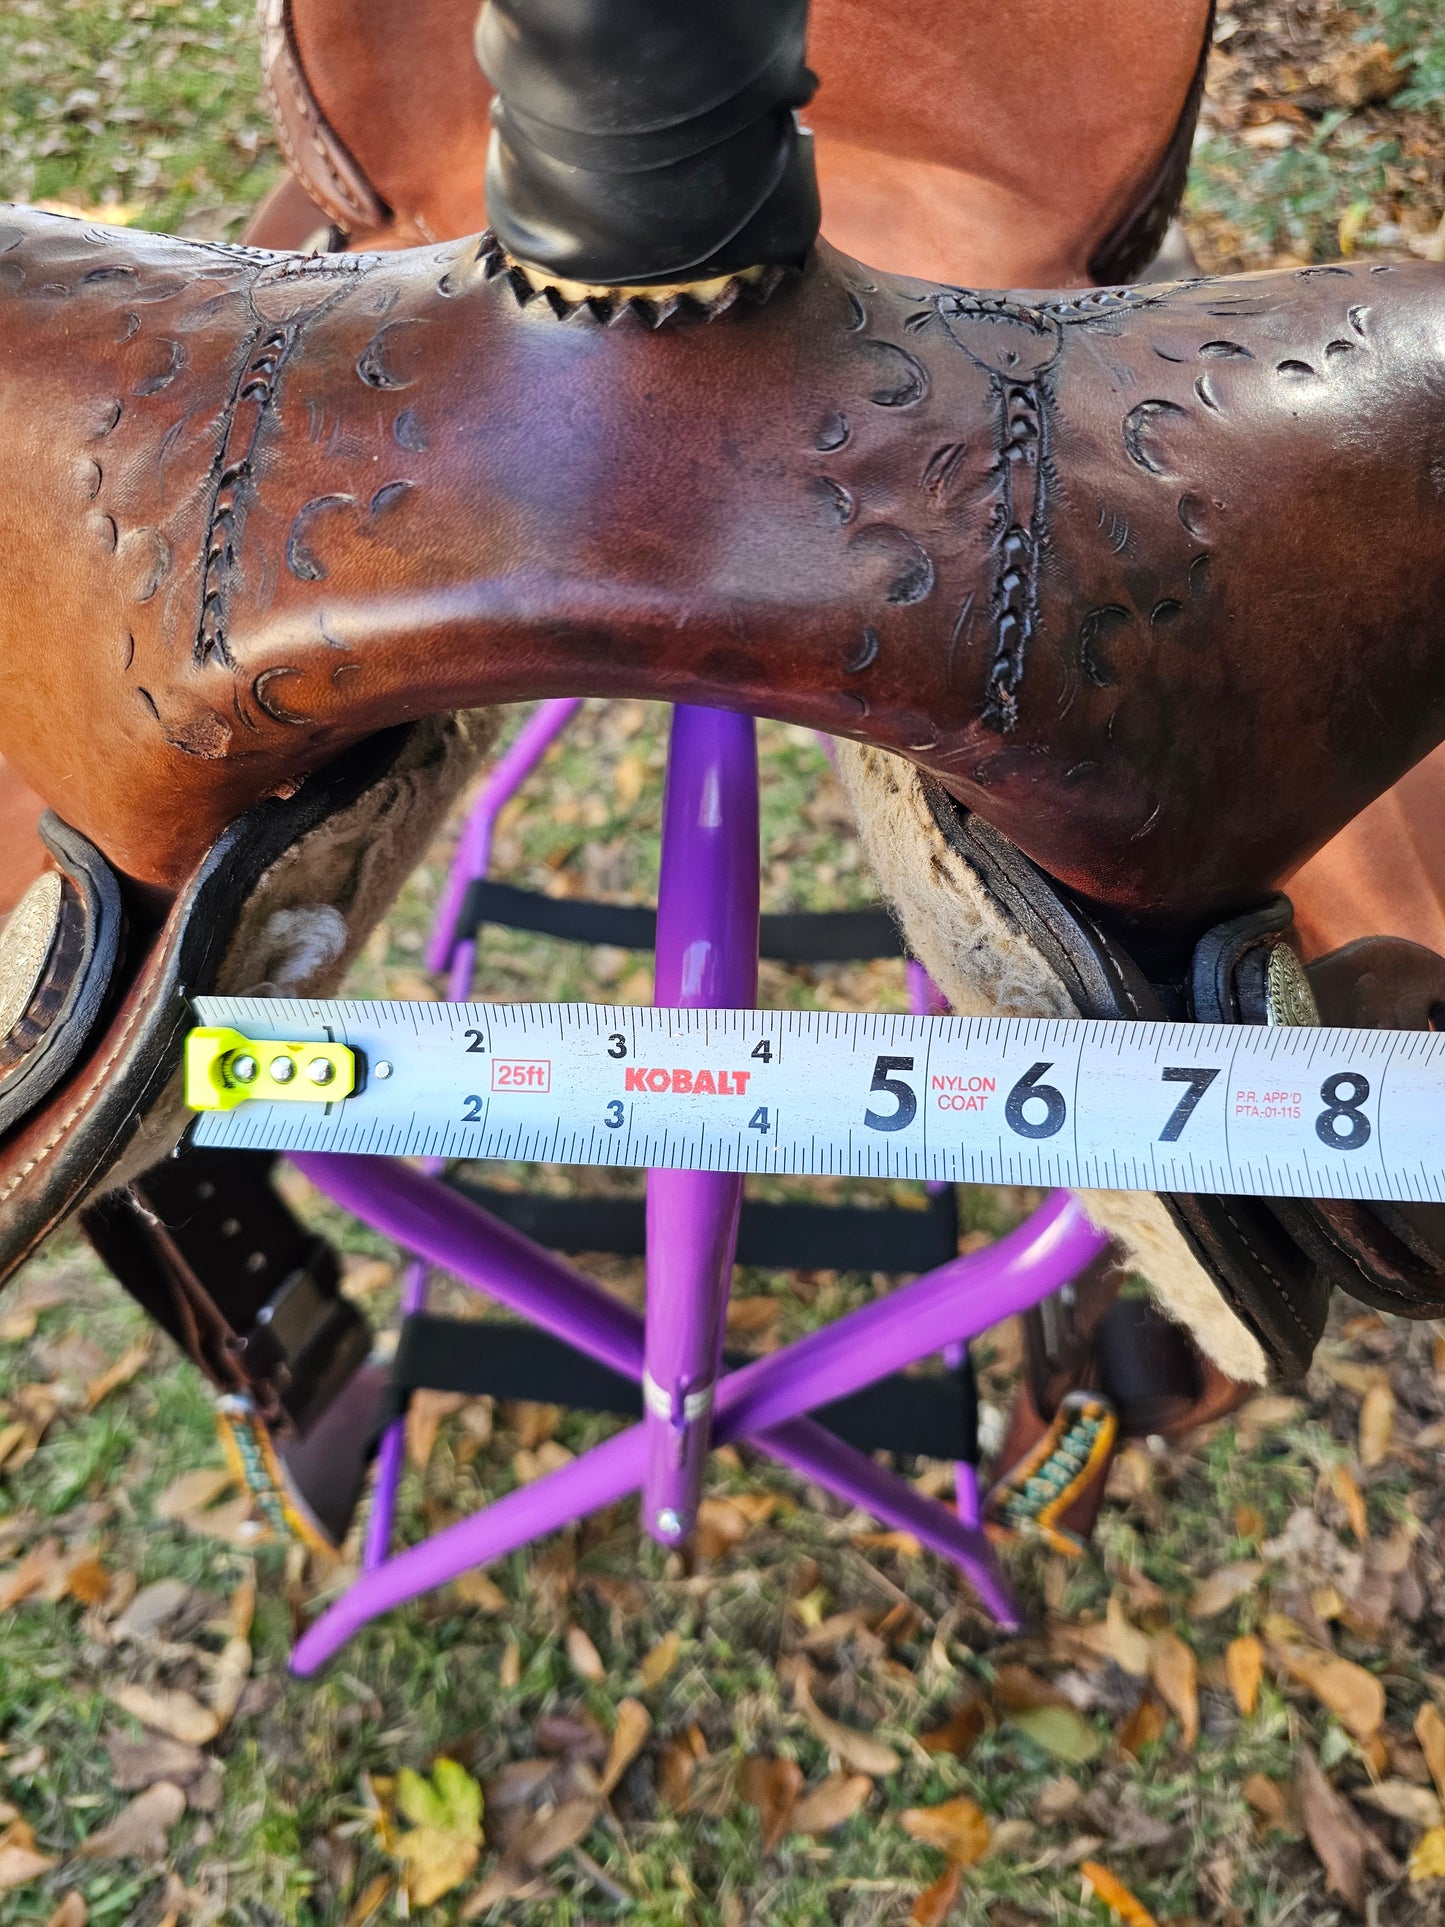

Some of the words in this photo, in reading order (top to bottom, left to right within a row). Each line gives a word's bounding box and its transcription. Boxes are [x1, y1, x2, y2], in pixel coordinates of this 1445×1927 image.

[464, 1029, 485, 1053] 2
[607, 1033, 628, 1060] 3
[751, 1039, 773, 1064] 4
[499, 1066, 545, 1086] 25ft
[624, 1067, 751, 1096] KOBALT
[931, 1074, 997, 1094] NYLON
[863, 1055, 918, 1132] 5
[937, 1094, 989, 1112] COAT
[1004, 1062, 1067, 1140] 6
[1157, 1066, 1222, 1142] 7
[1236, 1090, 1259, 1103] P.R.
[461, 1095, 483, 1122] 2
[604, 1100, 625, 1129] 3
[748, 1106, 771, 1134] 4
[1235, 1105, 1301, 1119] PTA-01-115
[1315, 1071, 1372, 1151] 8
